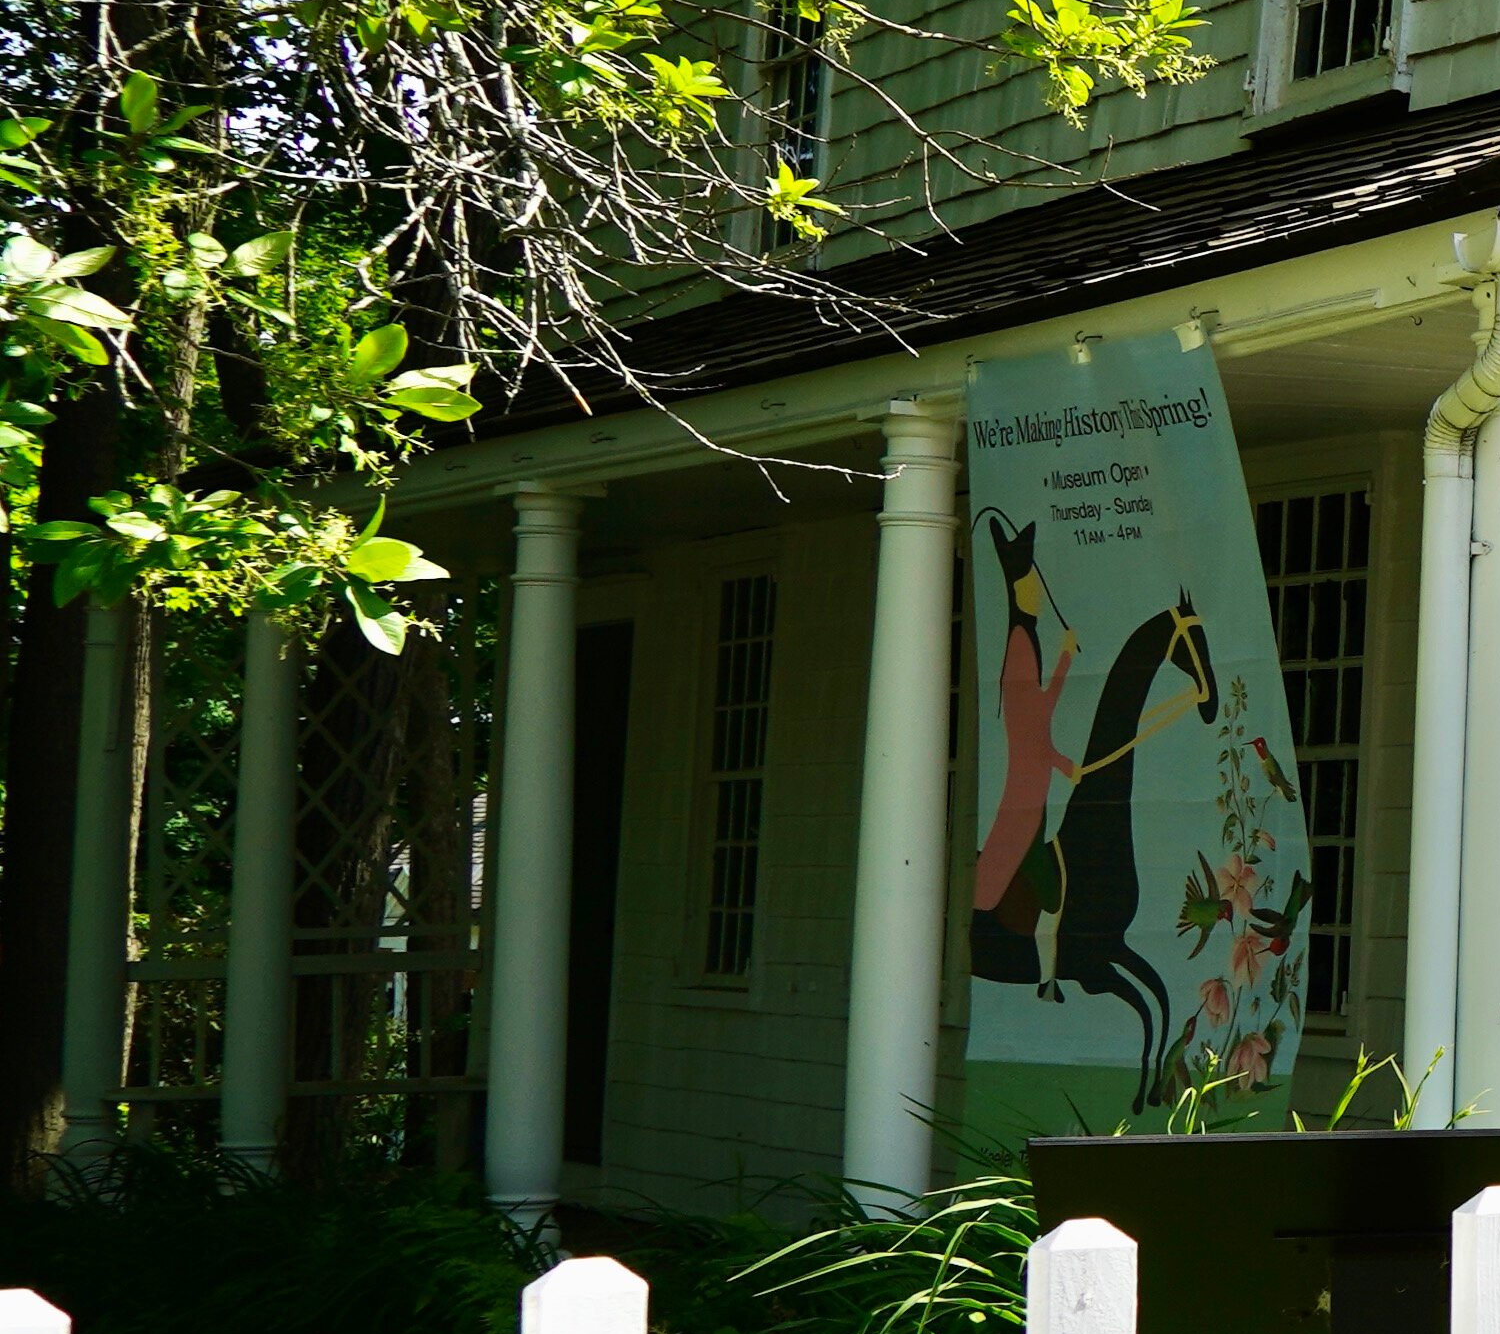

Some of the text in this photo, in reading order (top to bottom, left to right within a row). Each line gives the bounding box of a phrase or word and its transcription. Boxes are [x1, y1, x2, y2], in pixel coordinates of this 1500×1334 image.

[973, 418, 1014, 449] We're
[1015, 411, 1062, 447] Making
[1063, 405, 1125, 439] History
[1141, 387, 1213, 437] Spring!
[1051, 462, 1145, 491] Museum Open
[1050, 501, 1101, 521] Thursday
[1073, 530, 1105, 547] 11AM
[1116, 524, 1142, 540] 4PM
